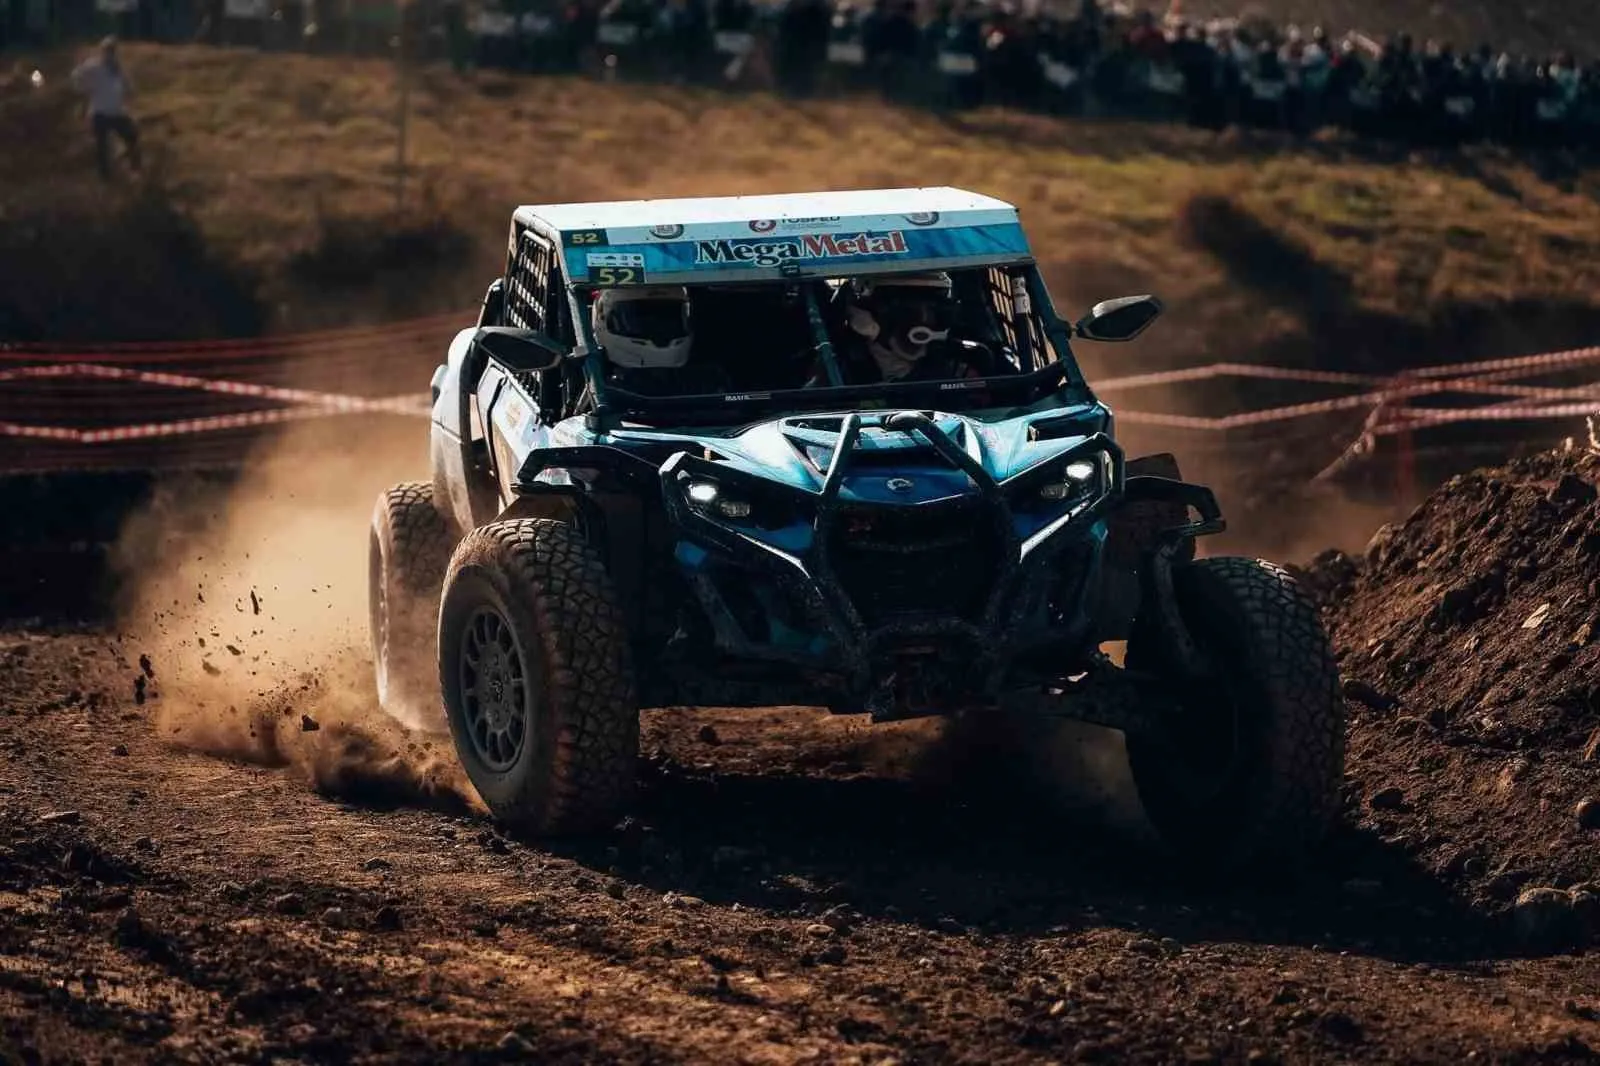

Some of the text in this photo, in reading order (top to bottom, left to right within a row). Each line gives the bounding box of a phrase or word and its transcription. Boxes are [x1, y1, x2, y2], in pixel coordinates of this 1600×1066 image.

[571, 233, 600, 244] 52
[695, 231, 908, 267] MegaMetal
[598, 268, 636, 285] 52
